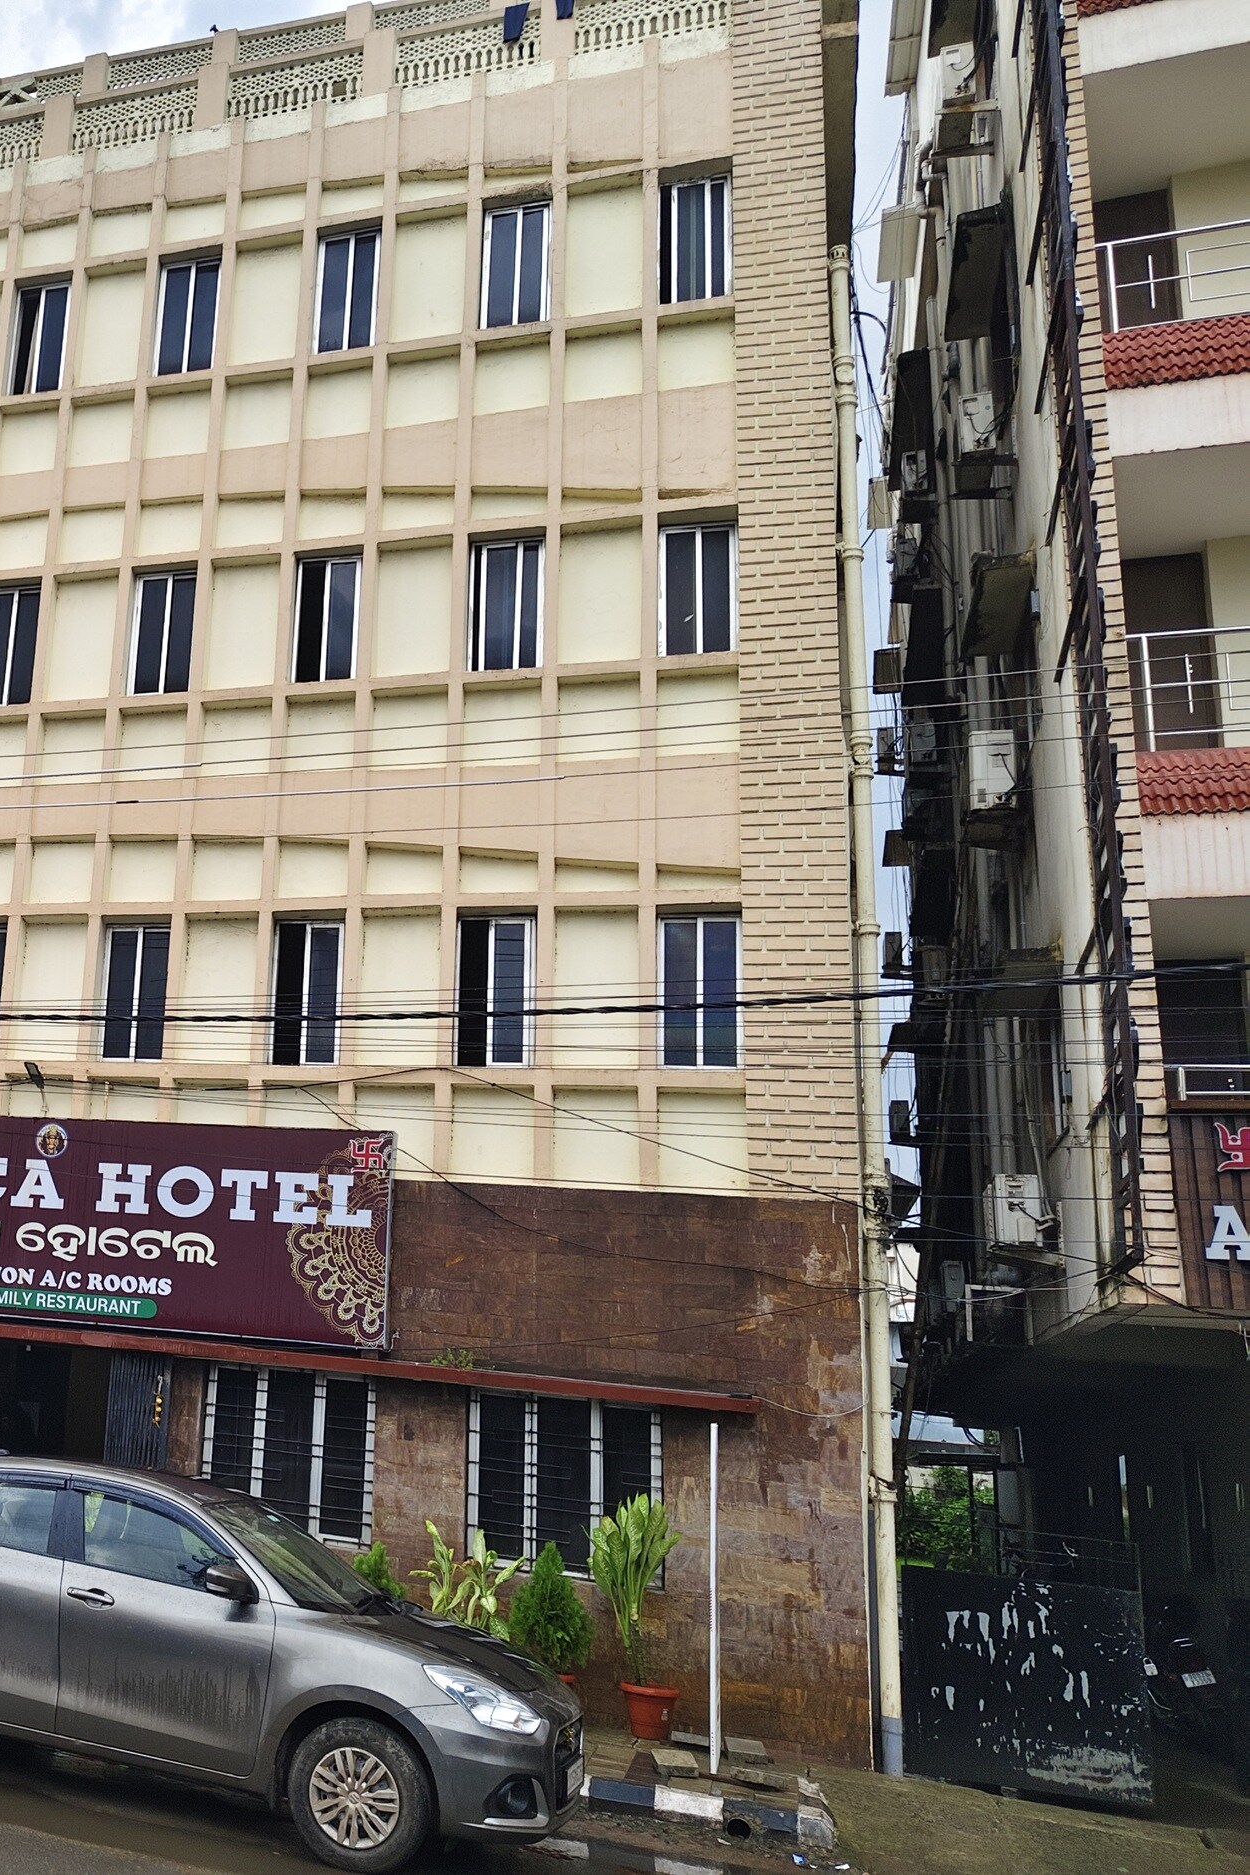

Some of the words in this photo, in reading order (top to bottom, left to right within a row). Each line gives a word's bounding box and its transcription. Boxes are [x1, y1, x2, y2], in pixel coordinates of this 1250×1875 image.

[96, 1161, 372, 1228] HOTEL
[39, 1268, 82, 1289] A/C
[86, 1272, 173, 1296] ROOMS
[36, 1294, 141, 1315] RESTAURANT
